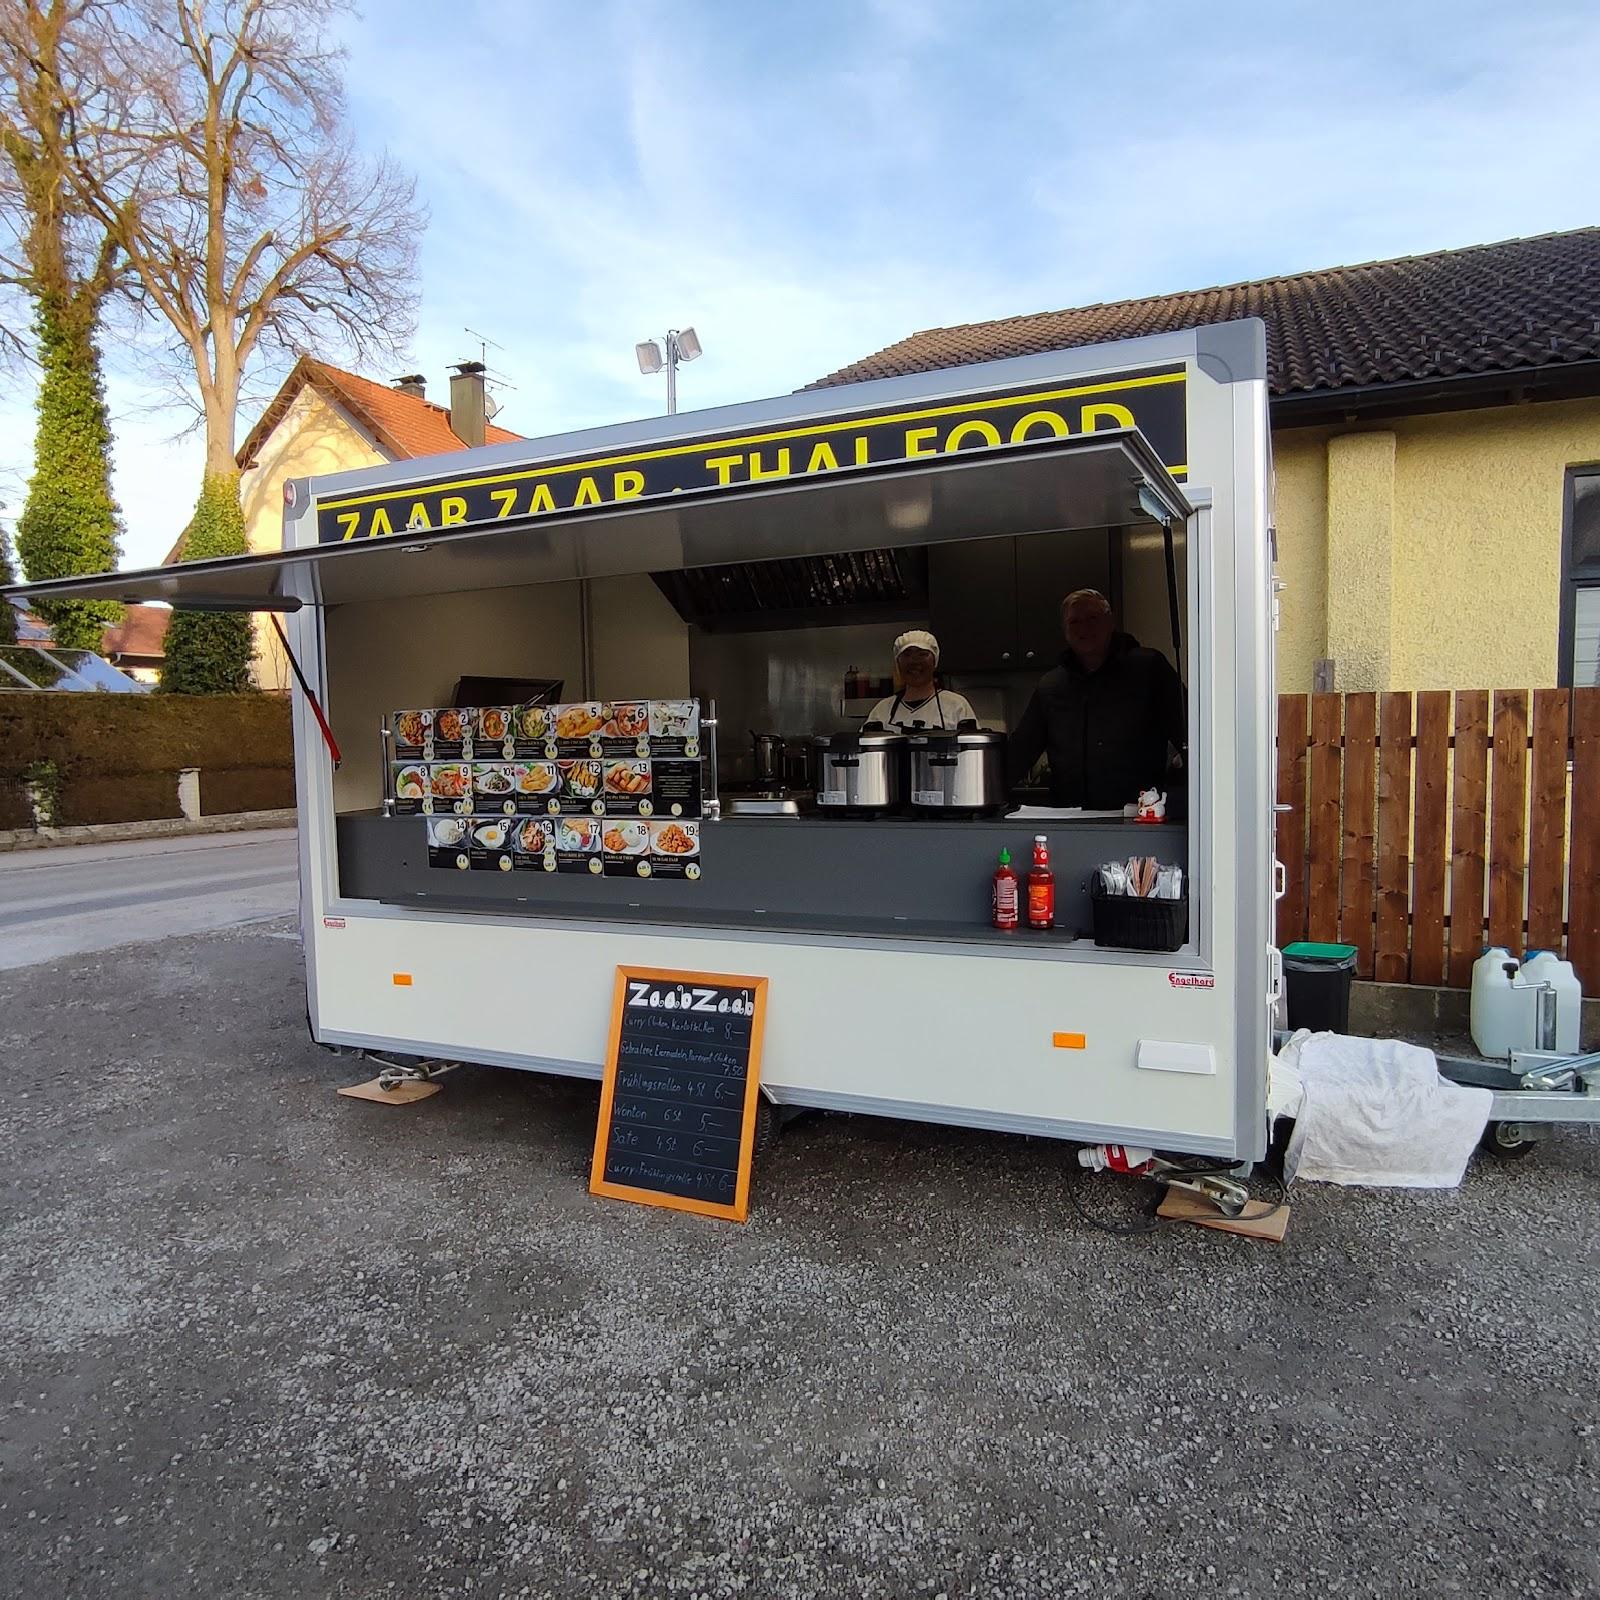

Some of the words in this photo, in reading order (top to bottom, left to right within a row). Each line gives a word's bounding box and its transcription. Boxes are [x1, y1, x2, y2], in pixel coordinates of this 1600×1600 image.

[457, 822, 465, 830] 14
[499, 822, 507, 832] 15
[543, 823, 551, 832] 16
[590, 824, 599, 833] 17
[637, 825, 646, 835] 18
[685, 826, 695, 835] 19
[613, 1101, 648, 1120] Wonton
[613, 1126, 639, 1146] Sate
